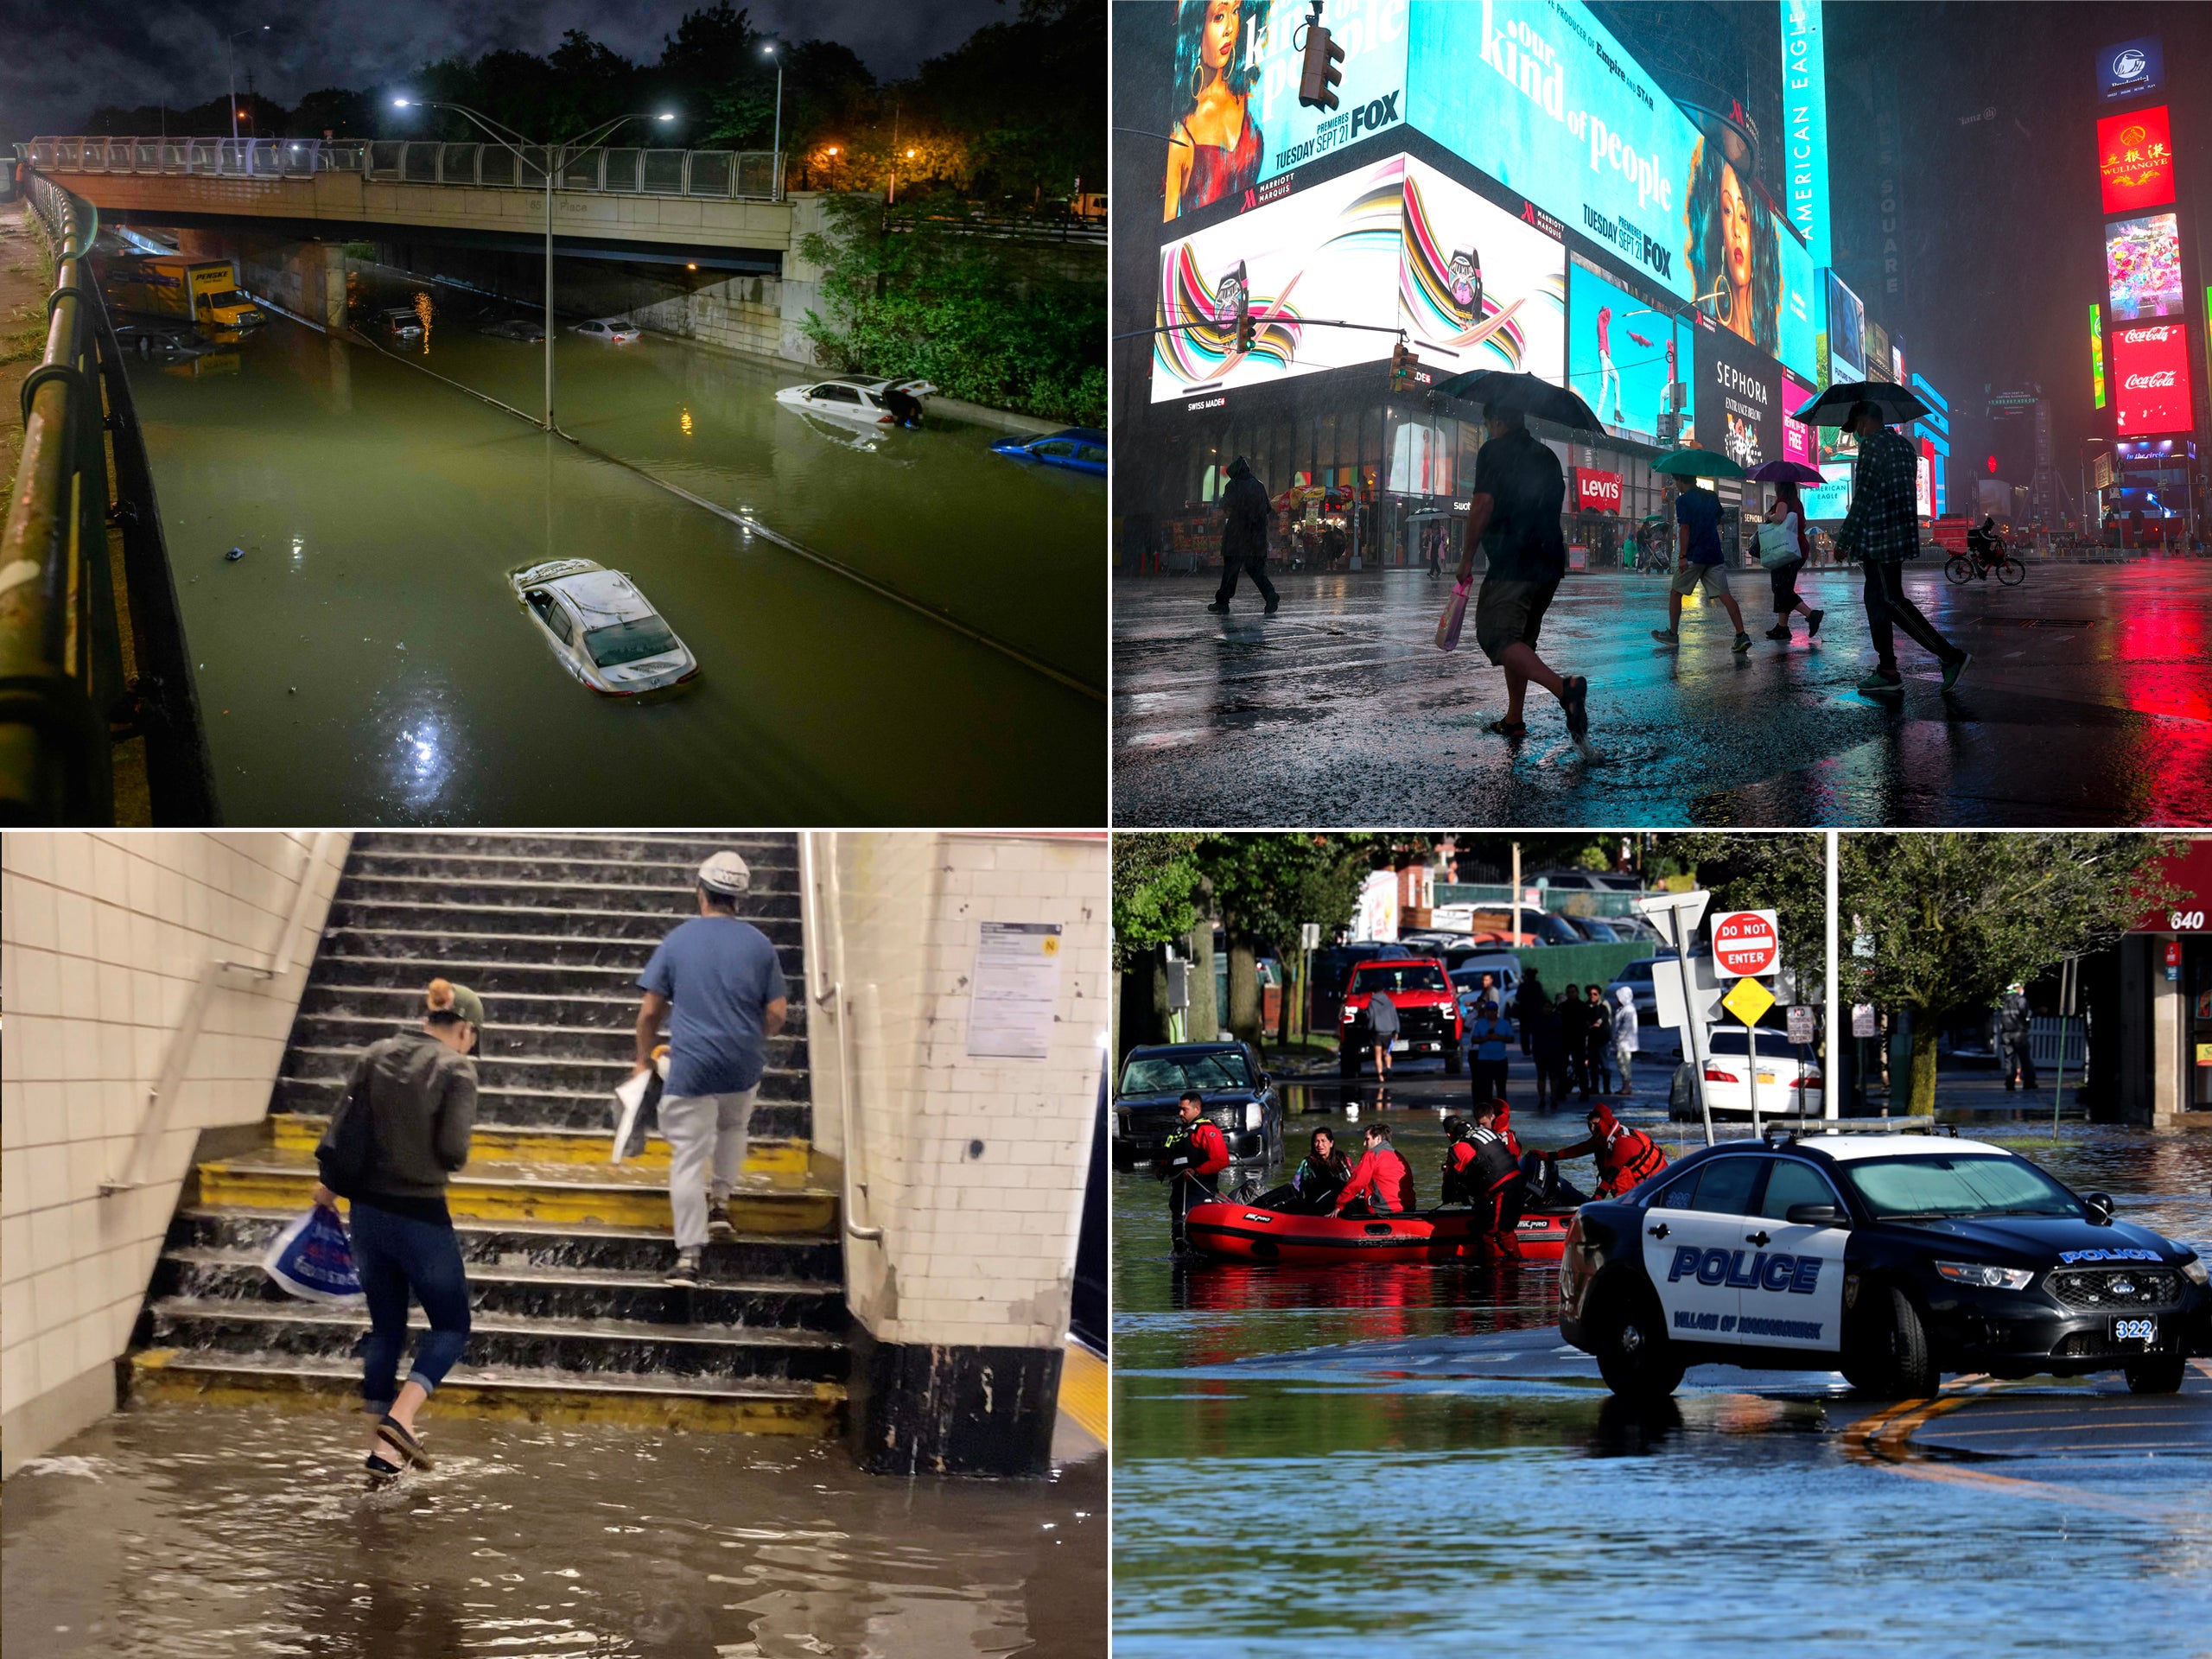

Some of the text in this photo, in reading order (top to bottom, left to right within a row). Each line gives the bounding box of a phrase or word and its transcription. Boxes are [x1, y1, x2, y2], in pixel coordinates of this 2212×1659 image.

[1518, 20, 1555, 69] our
[1557, 3, 1586, 41] PRODUCER
[1588, 36, 1595, 49] OF
[1596, 41, 1625, 81] Empire
[1637, 85, 1654, 111] STAR
[1351, 89, 1400, 138] FOX
[1317, 112, 1350, 135] PREMIERES
[1789, 12, 1813, 240] AMERICAN EAGLE
[1275, 124, 1348, 170] TUESDAY SEPT 21
[1567, 110, 1587, 143] of
[1590, 115, 1671, 212] people
[2102, 158, 2168, 175] WULIANGYE
[1260, 173, 1294, 193] MARRIOTT
[1259, 185, 1290, 202] MARQUIS
[560, 201, 588, 213] Place
[1537, 219, 1561, 238] MARQUIS
[1538, 211, 1564, 232] MARRIOTT
[1618, 216, 1642, 240] PREMIERES
[1583, 203, 1642, 261] TUESDAY SEPT 21
[1643, 234, 1672, 281] FOX
[195, 270, 228, 281] PENSKE
[2125, 326, 2170, 343] Coca-Cola
[1717, 361, 1768, 405] SEPHORA
[2125, 371, 2177, 390] Coca-Cola
[1188, 398, 1221, 411] SWISS MADE
[1789, 429, 1802, 451] FREE
[1745, 513, 1763, 523] SEPHORA
[2171, 911, 2204, 930] 640
[1722, 924, 1766, 937] DO NOT
[1046, 941, 1055, 951] N
[1728, 952, 1764, 964] ENTER
[2059, 1249, 2163, 1263] POLICE
[1668, 1245, 1823, 1294] POLICE
[1720, 1315, 1737, 1332] OF
[2116, 1320, 2152, 1338] 322
